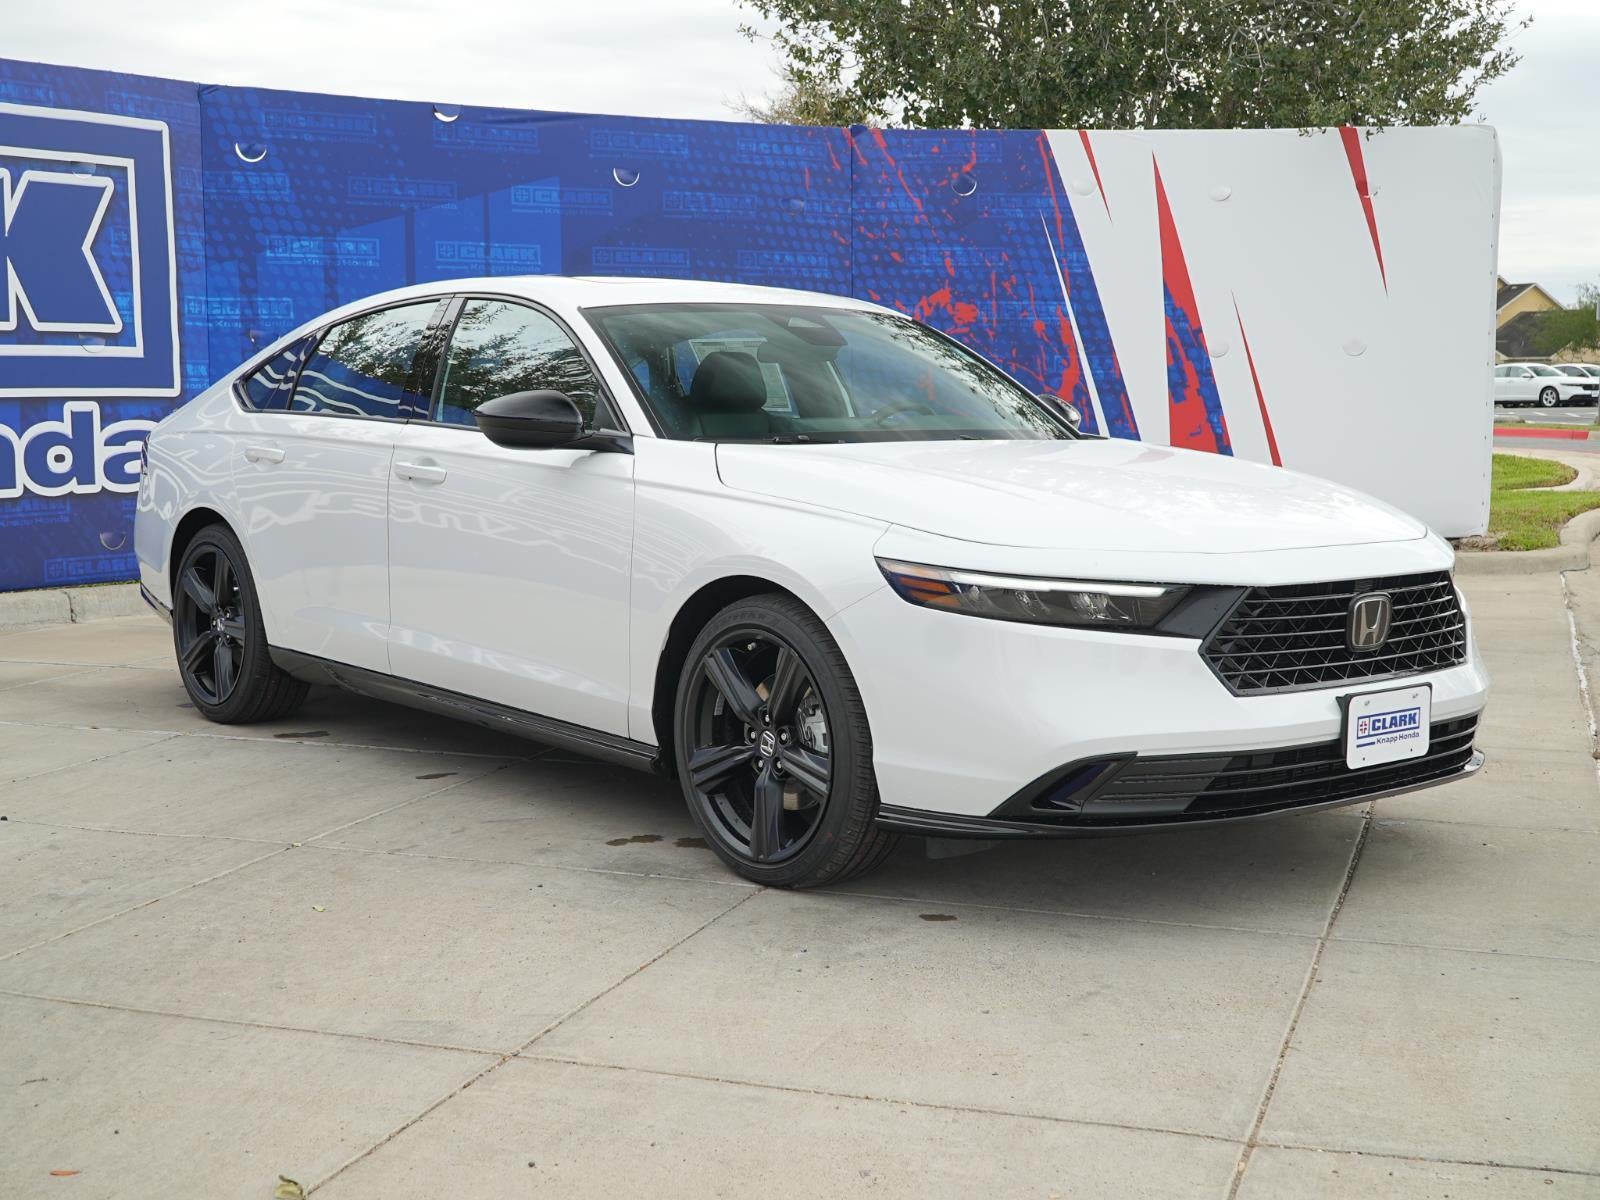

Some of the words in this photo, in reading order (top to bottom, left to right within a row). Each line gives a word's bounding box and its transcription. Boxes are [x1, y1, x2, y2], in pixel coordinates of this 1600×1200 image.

[0, 401, 157, 497] da
[1371, 712, 1417, 731] CLARK
[1376, 735, 1398, 745] Knapp
[1398, 731, 1420, 742] Honda
